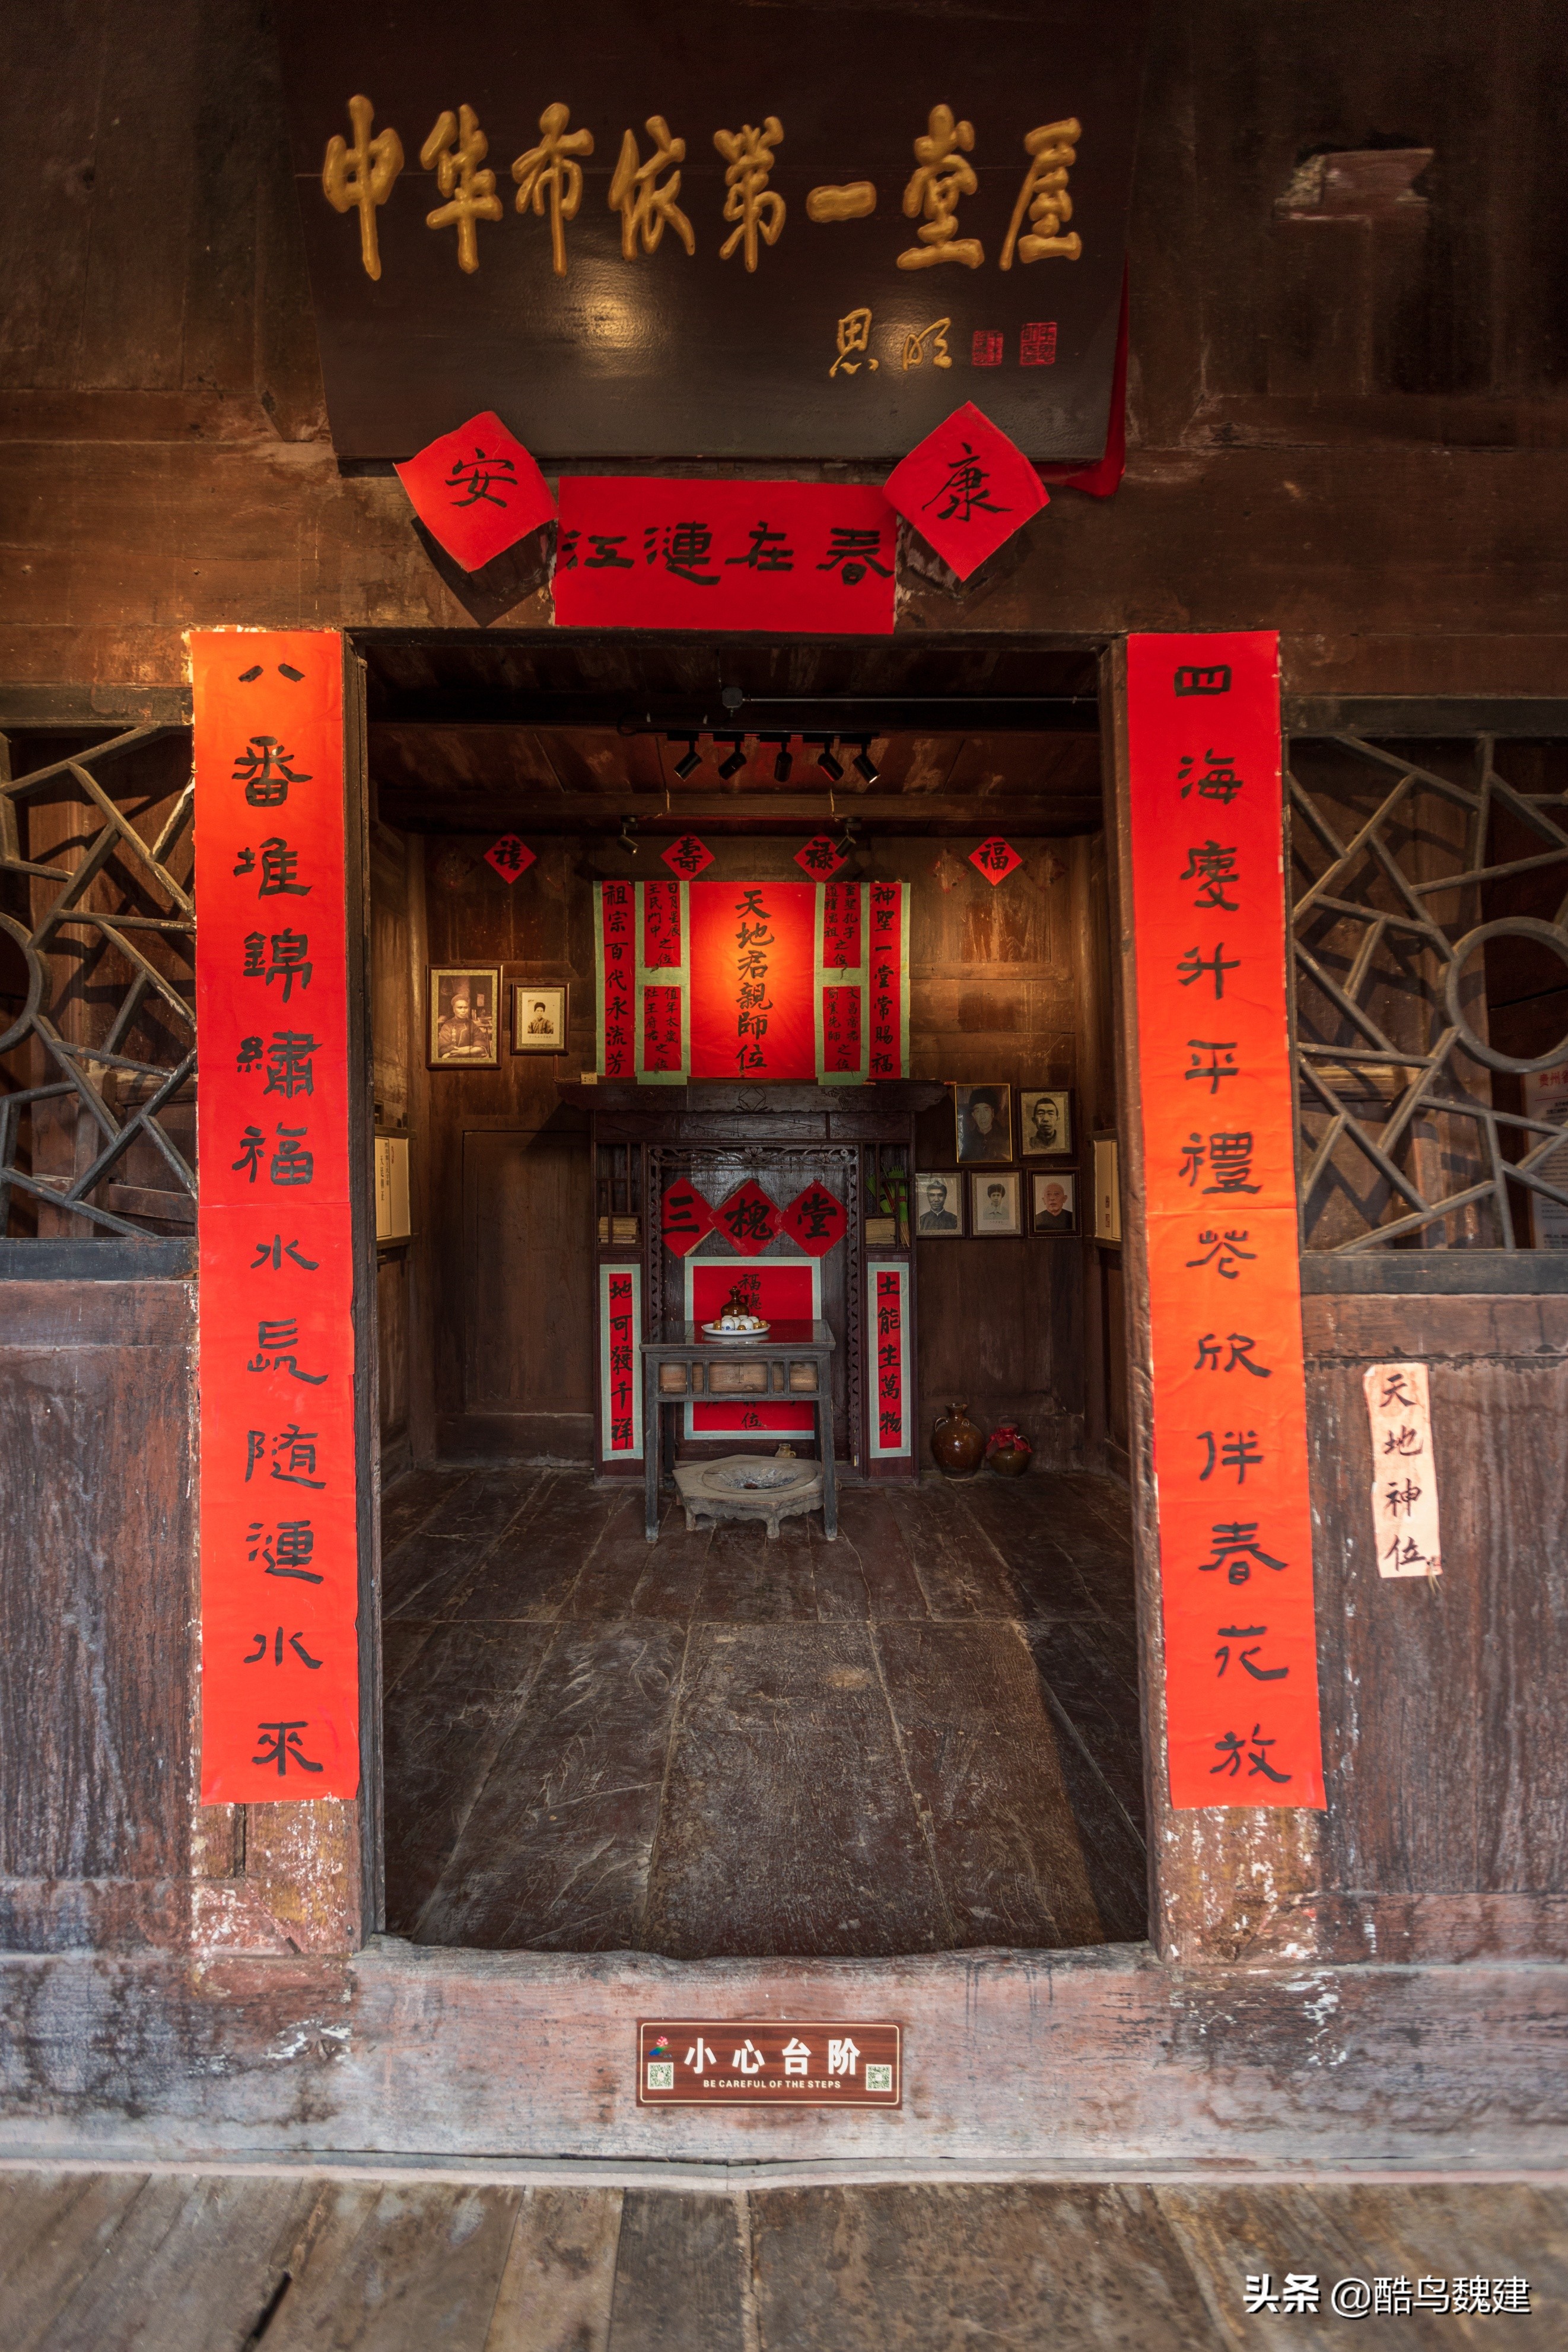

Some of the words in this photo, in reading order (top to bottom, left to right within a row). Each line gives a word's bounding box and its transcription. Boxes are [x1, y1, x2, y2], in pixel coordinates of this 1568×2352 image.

[444, 447, 519, 509] 安
[921, 441, 1014, 523] 康
[978, 841, 1010, 871] 福
[602, 884, 629, 1076] 祖宗百代永流芳
[734, 888, 775, 1071] 天地君親師位
[1379, 1373, 1426, 1572] 天地神位
[683, 2037, 861, 2076] 小心台阶
[703, 2079, 717, 2088] BE
[718, 2079, 766, 2088] CAREFUL
[769, 2080, 783, 2088] OF
[785, 2080, 805, 2089] THE
[807, 2080, 841, 2089] STEPS
